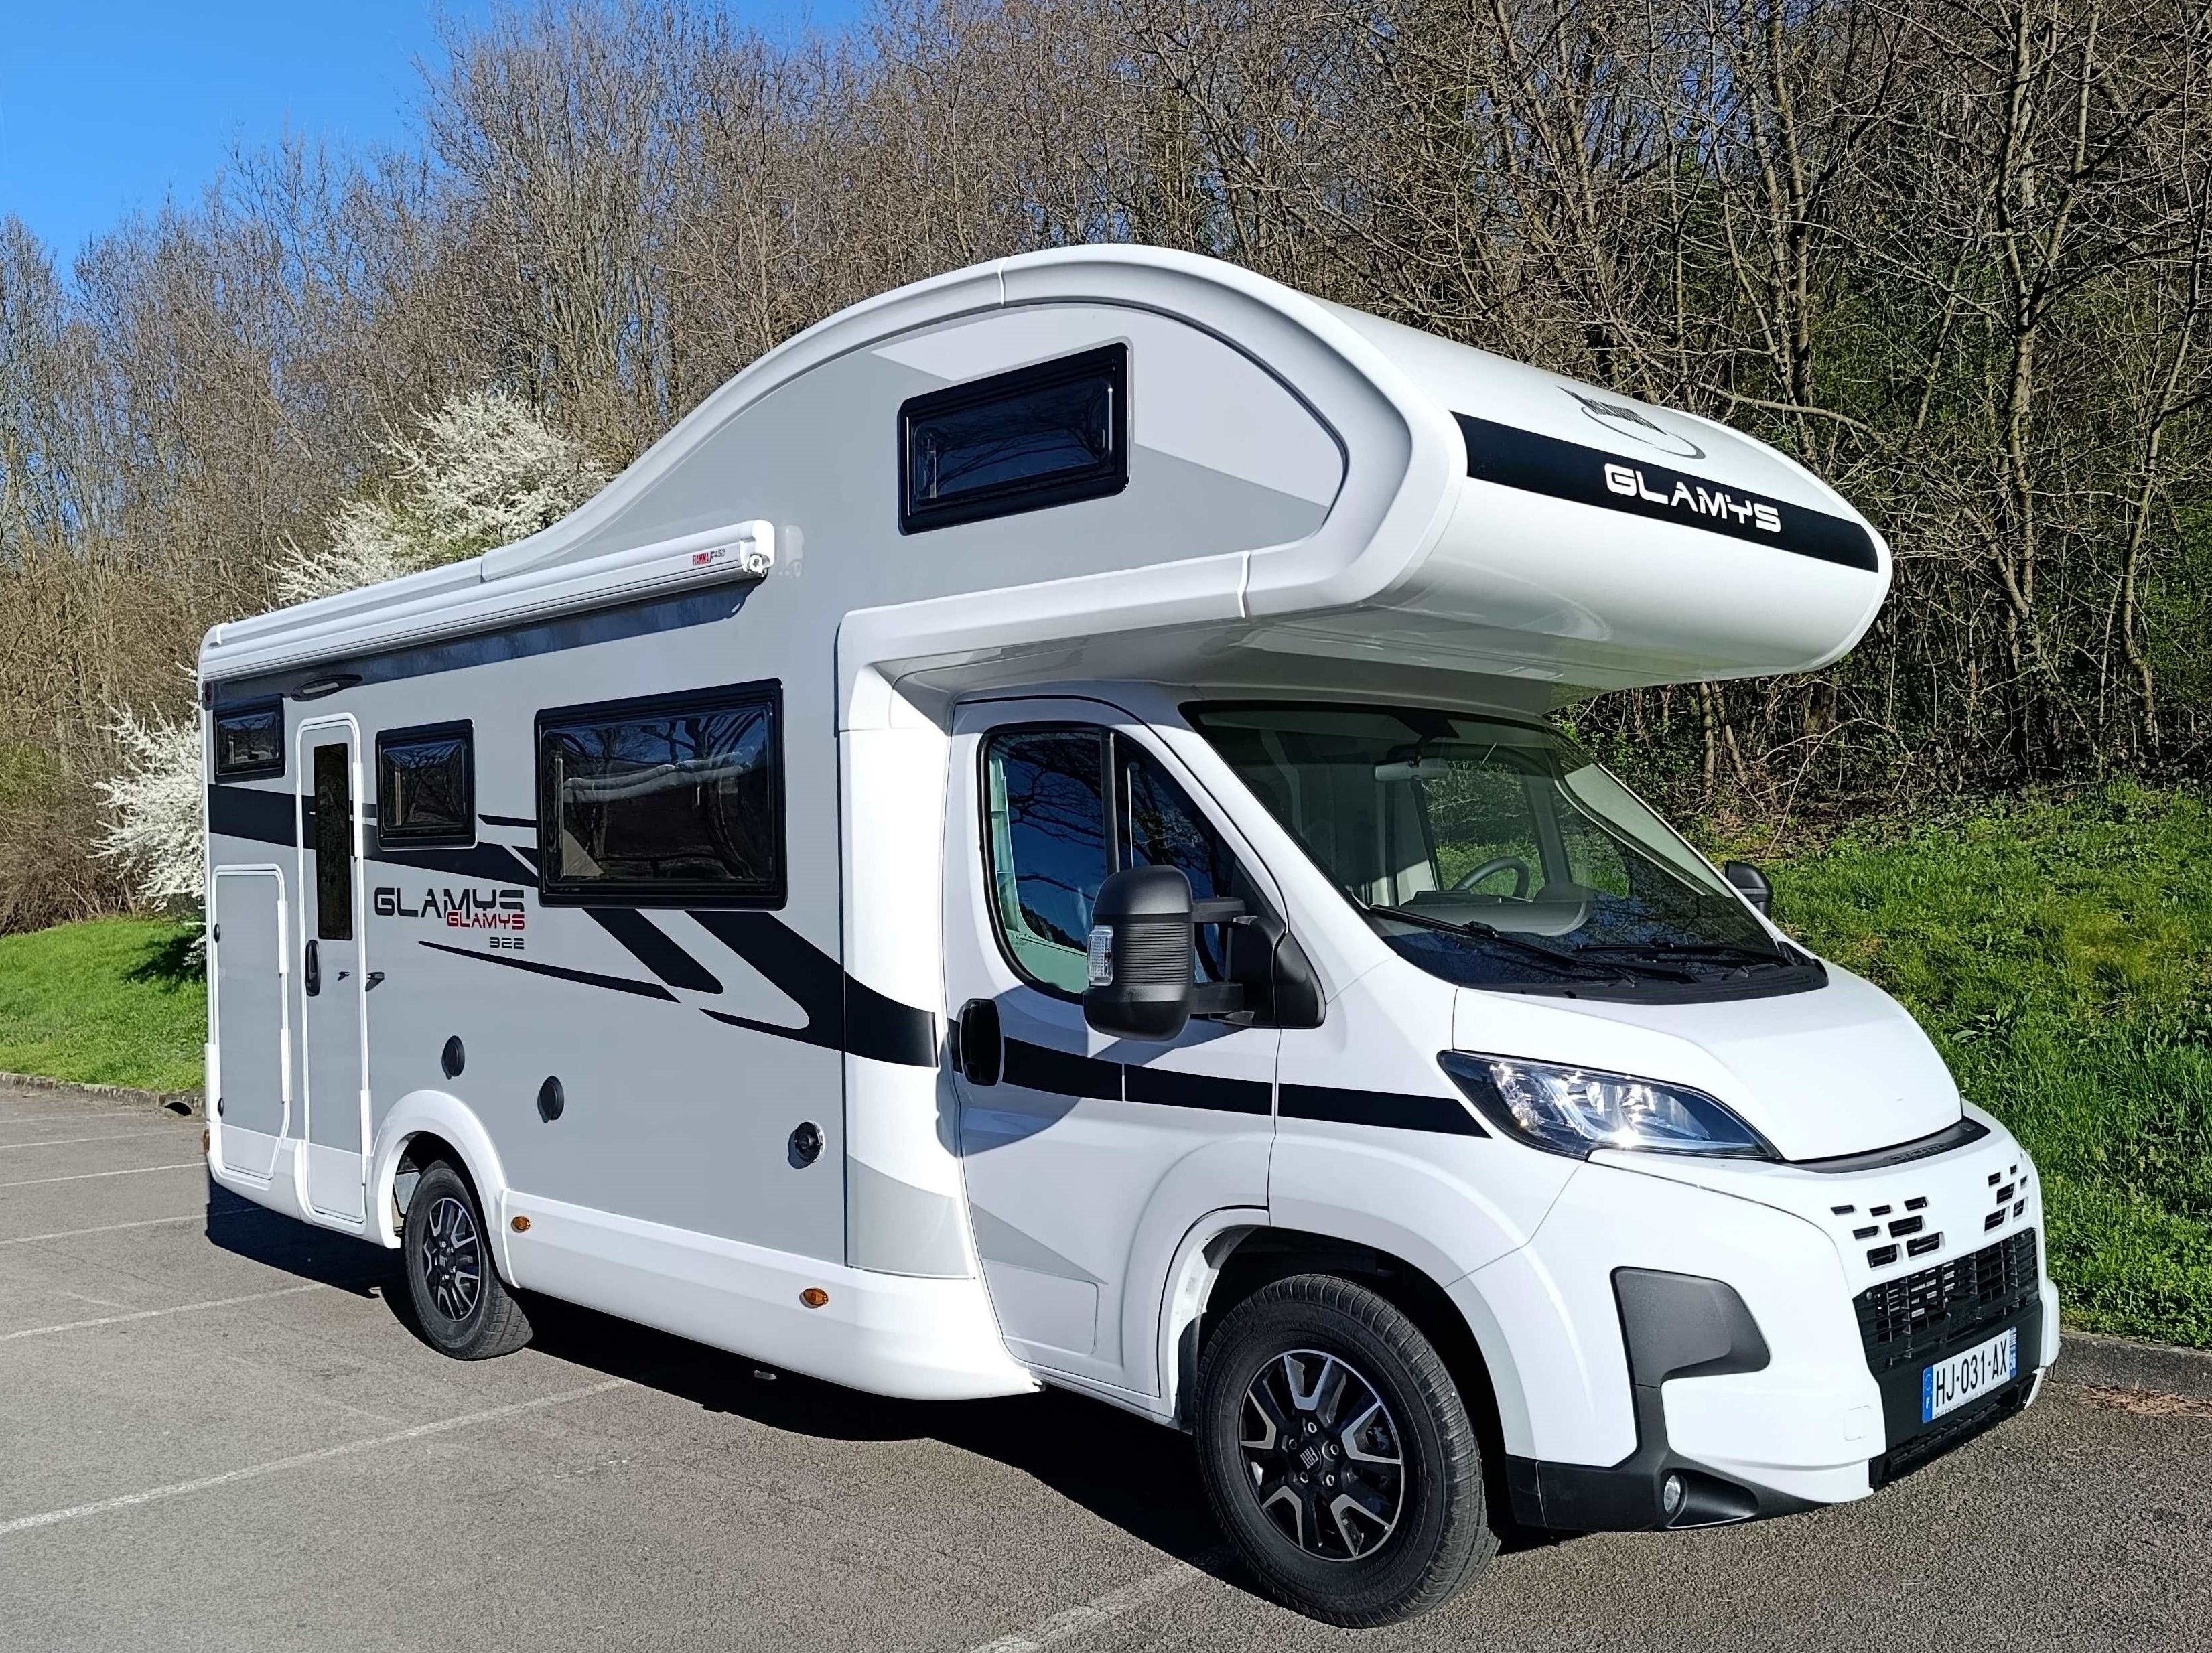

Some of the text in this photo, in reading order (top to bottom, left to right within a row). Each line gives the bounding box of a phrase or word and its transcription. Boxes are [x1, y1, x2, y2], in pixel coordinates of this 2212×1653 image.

[1604, 463, 1781, 533] GLAMYS
[374, 887, 525, 919] GLAMYS
[447, 912, 525, 930] GLAMYS
[490, 937, 525, 950] 322
[1935, 1338, 2008, 1408] HJ-031-AX
[1300, 1446, 1319, 1470] FIAT
